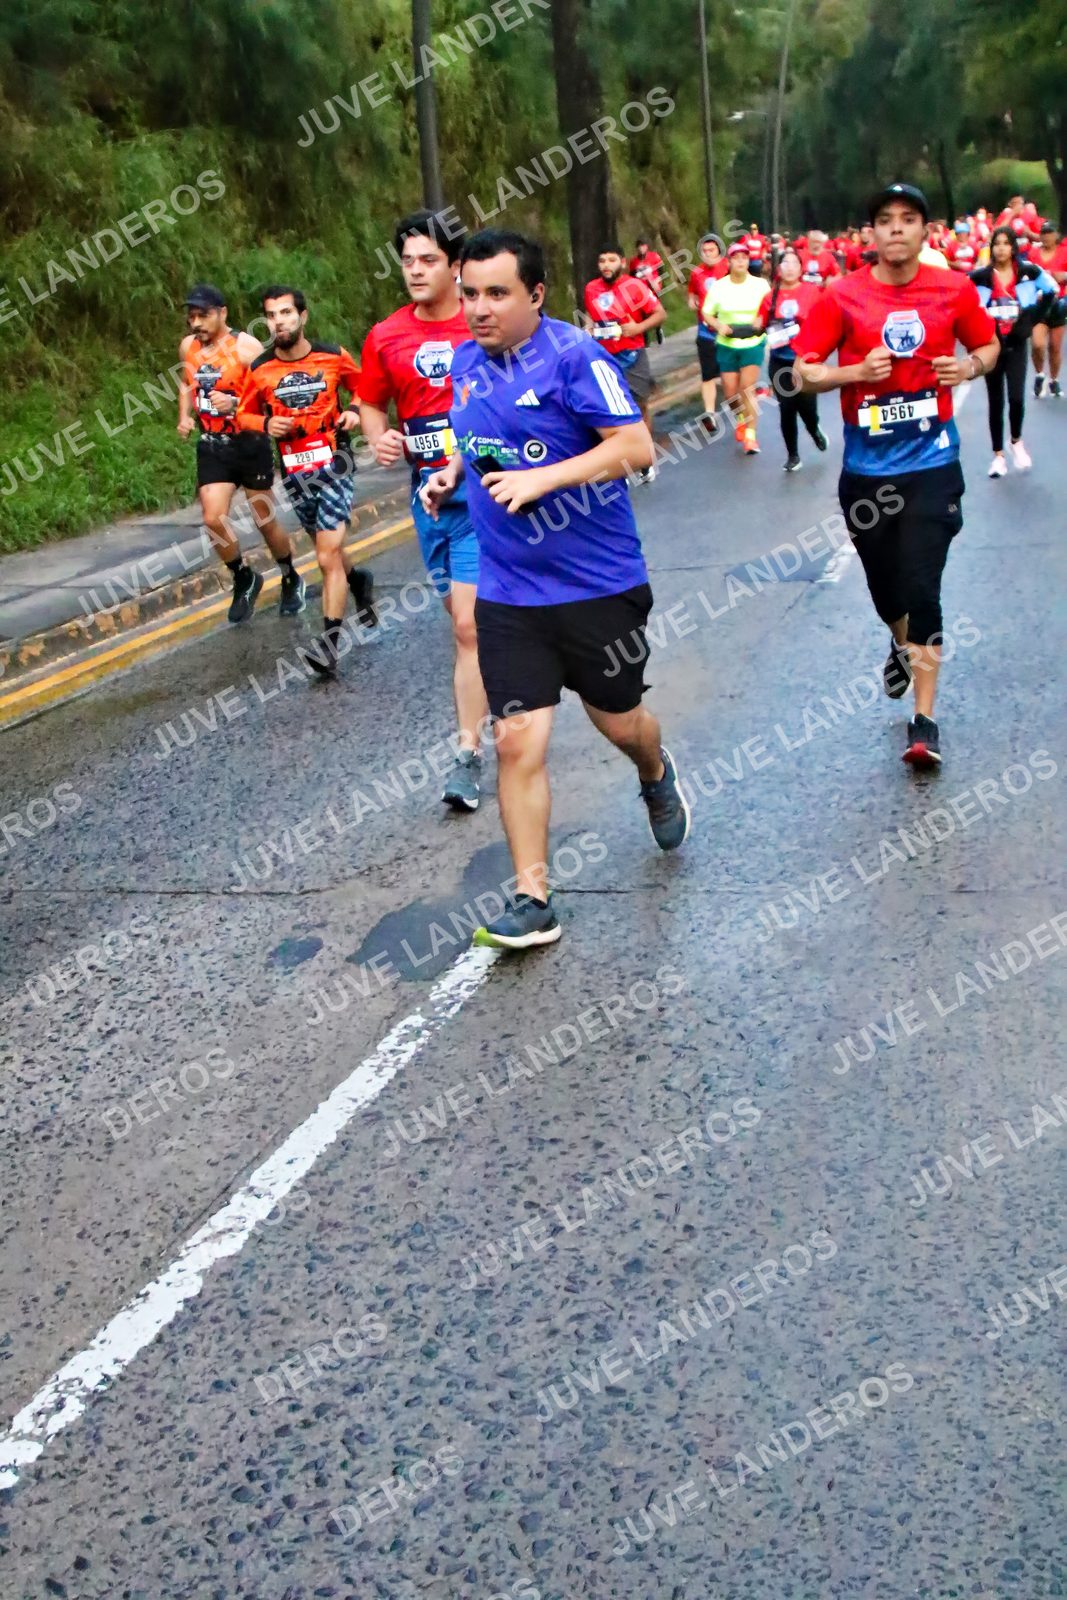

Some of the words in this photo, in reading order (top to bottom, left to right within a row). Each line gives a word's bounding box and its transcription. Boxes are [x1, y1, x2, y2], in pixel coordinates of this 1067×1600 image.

[881, 403, 915, 422] 4954
[414, 434, 440, 451] 4956
[295, 451, 315, 464] 2297
